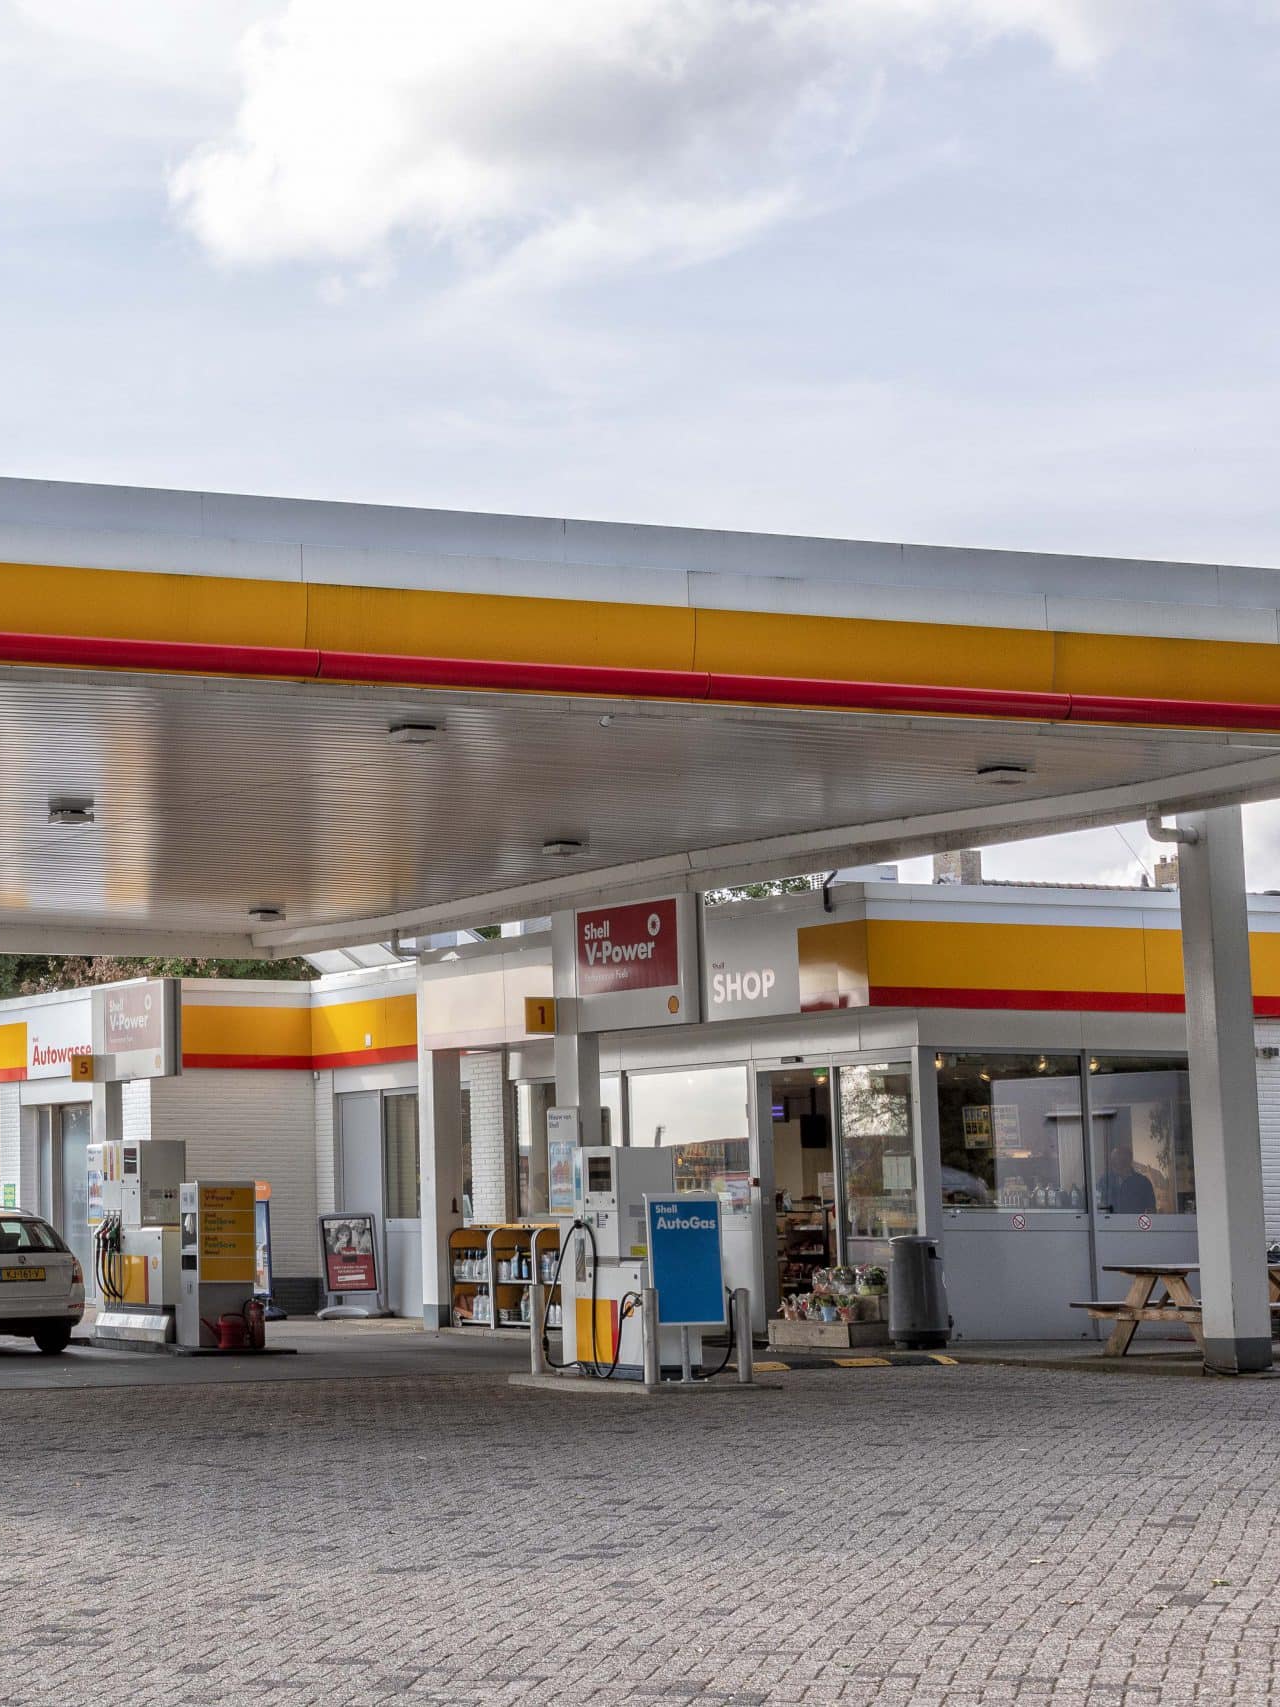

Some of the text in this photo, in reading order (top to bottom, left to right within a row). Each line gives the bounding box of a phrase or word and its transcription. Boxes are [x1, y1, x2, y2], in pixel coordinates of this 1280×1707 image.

[585, 919, 610, 940] Shell
[585, 940, 656, 966] V-Power
[712, 969, 776, 1004] SHOP
[110, 1014, 149, 1031] V-Power
[537, 1005, 546, 1025] 1
[32, 1044, 92, 1067] Autowasse
[79, 1061, 89, 1075] 5
[655, 1204, 678, 1214] Shell
[656, 1216, 716, 1230] AutoGas
